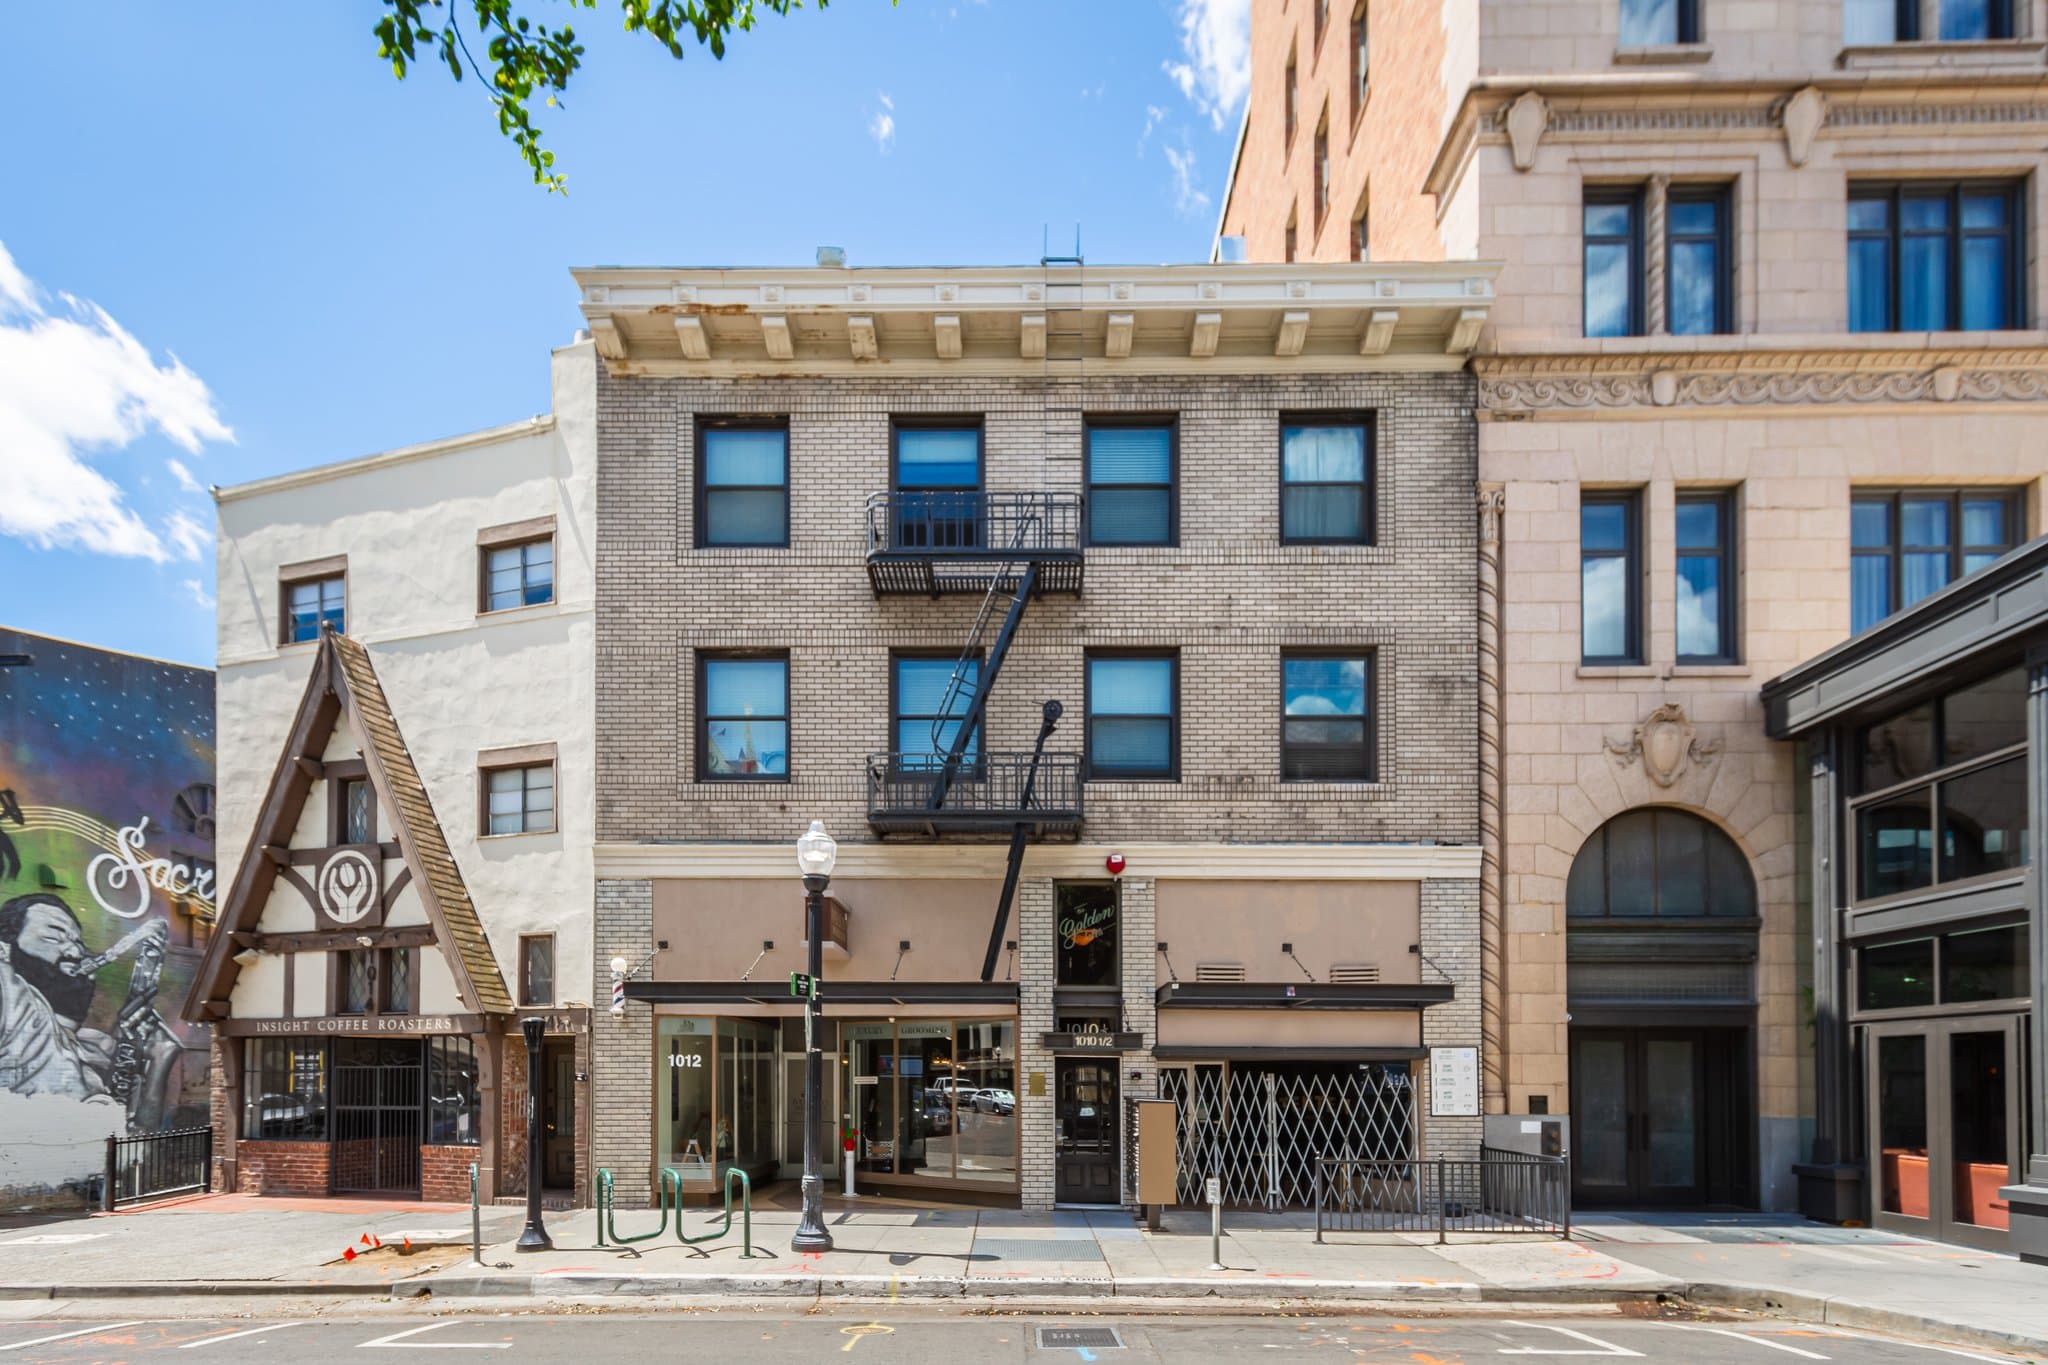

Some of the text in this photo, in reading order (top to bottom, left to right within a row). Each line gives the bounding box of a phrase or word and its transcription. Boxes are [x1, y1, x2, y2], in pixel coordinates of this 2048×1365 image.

[1059, 904, 1115, 949] Golden
[256, 1018, 452, 1032] INSIGHT COFFEE ROASTERS
[901, 1026, 947, 1034] GROOMING
[1074, 1036, 1113, 1046] 1010 1/2
[667, 1054, 702, 1067] 1012
